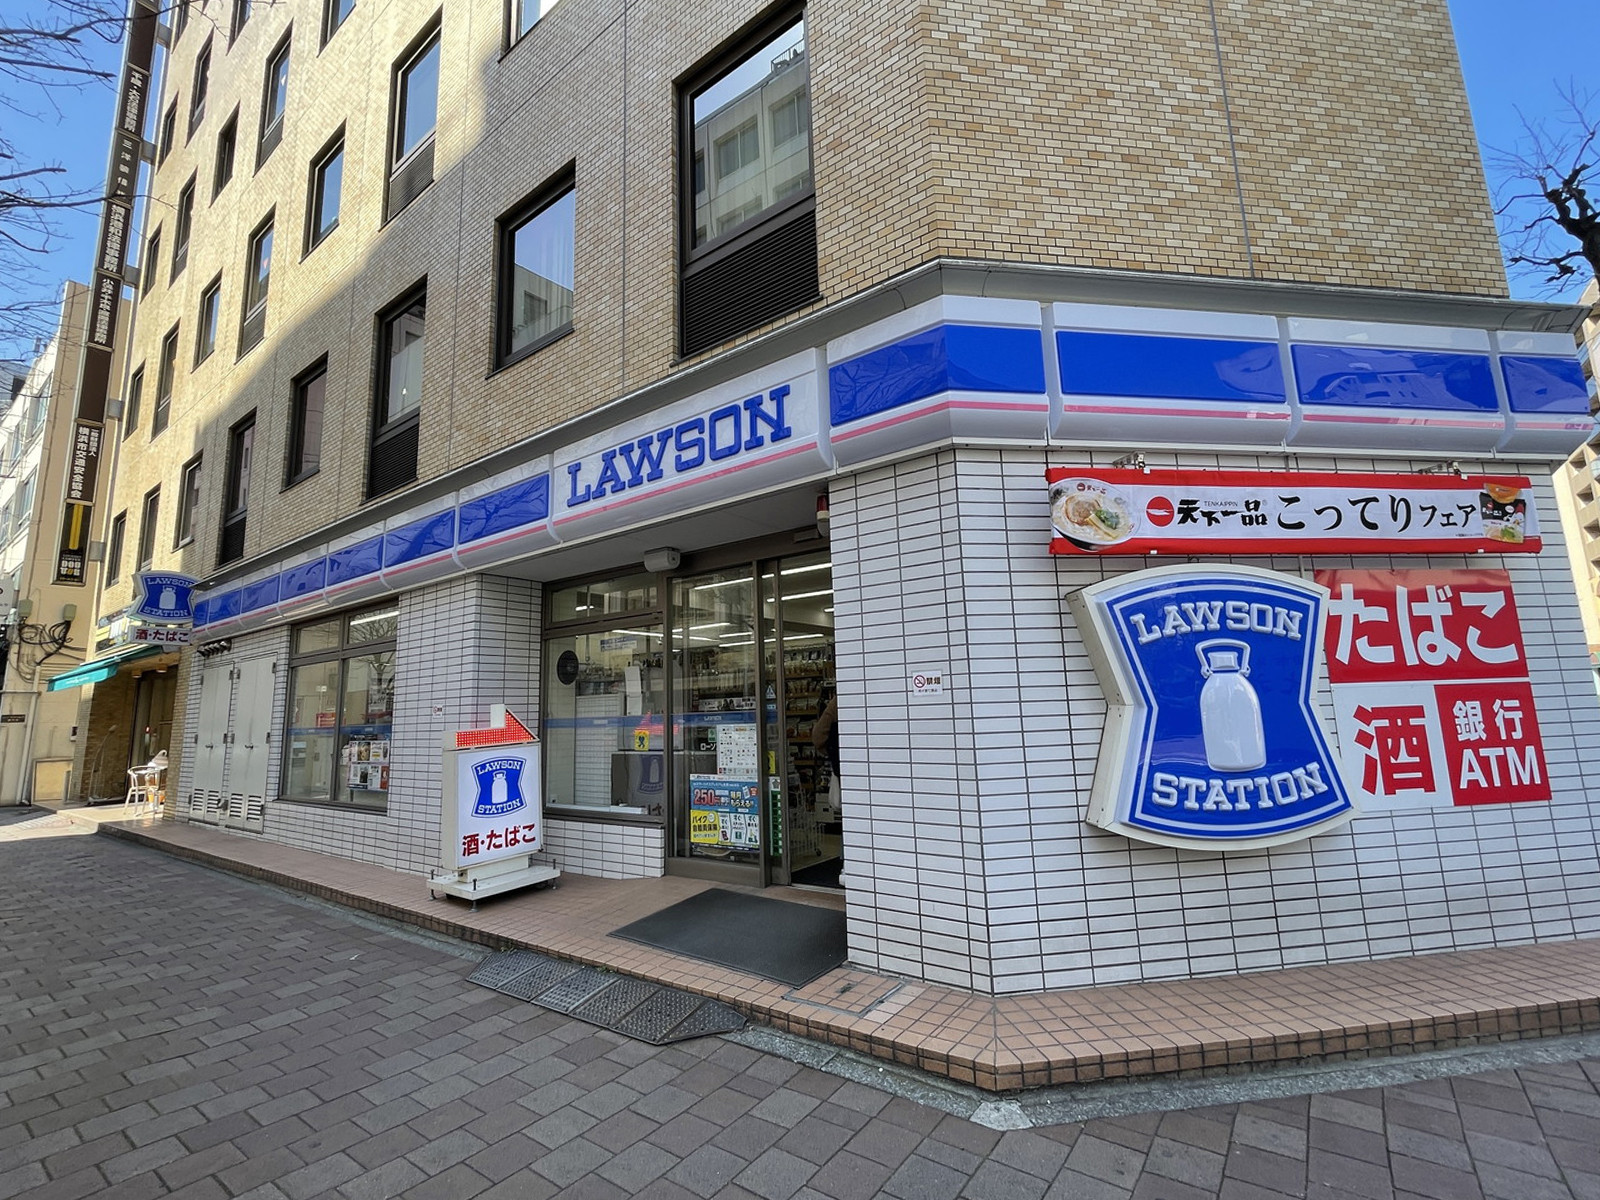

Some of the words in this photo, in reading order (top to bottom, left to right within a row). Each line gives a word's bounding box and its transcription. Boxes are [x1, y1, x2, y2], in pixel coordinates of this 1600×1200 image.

[70, 426, 90, 499] 横浜市交通安全協会
[567, 384, 792, 507] LAWSON
[1177, 499, 1268, 527] 天下一品
[1276, 494, 1477, 533] こってりフェア
[146, 577, 194, 588] LAWSON
[143, 606, 188, 617] STATION
[1130, 600, 1303, 645] LAWSON
[1328, 583, 1519, 667] たばこ
[135, 629, 189, 643] 酒・たばこ
[1452, 698, 1524, 743] 銀行
[476, 759, 522, 775] LAWSON
[1353, 705, 1436, 796] 酒
[1459, 746, 1542, 790] ATM
[476, 798, 521, 815] STATION
[1152, 762, 1328, 811] STATION
[462, 823, 536, 858] 酒・たばこ
